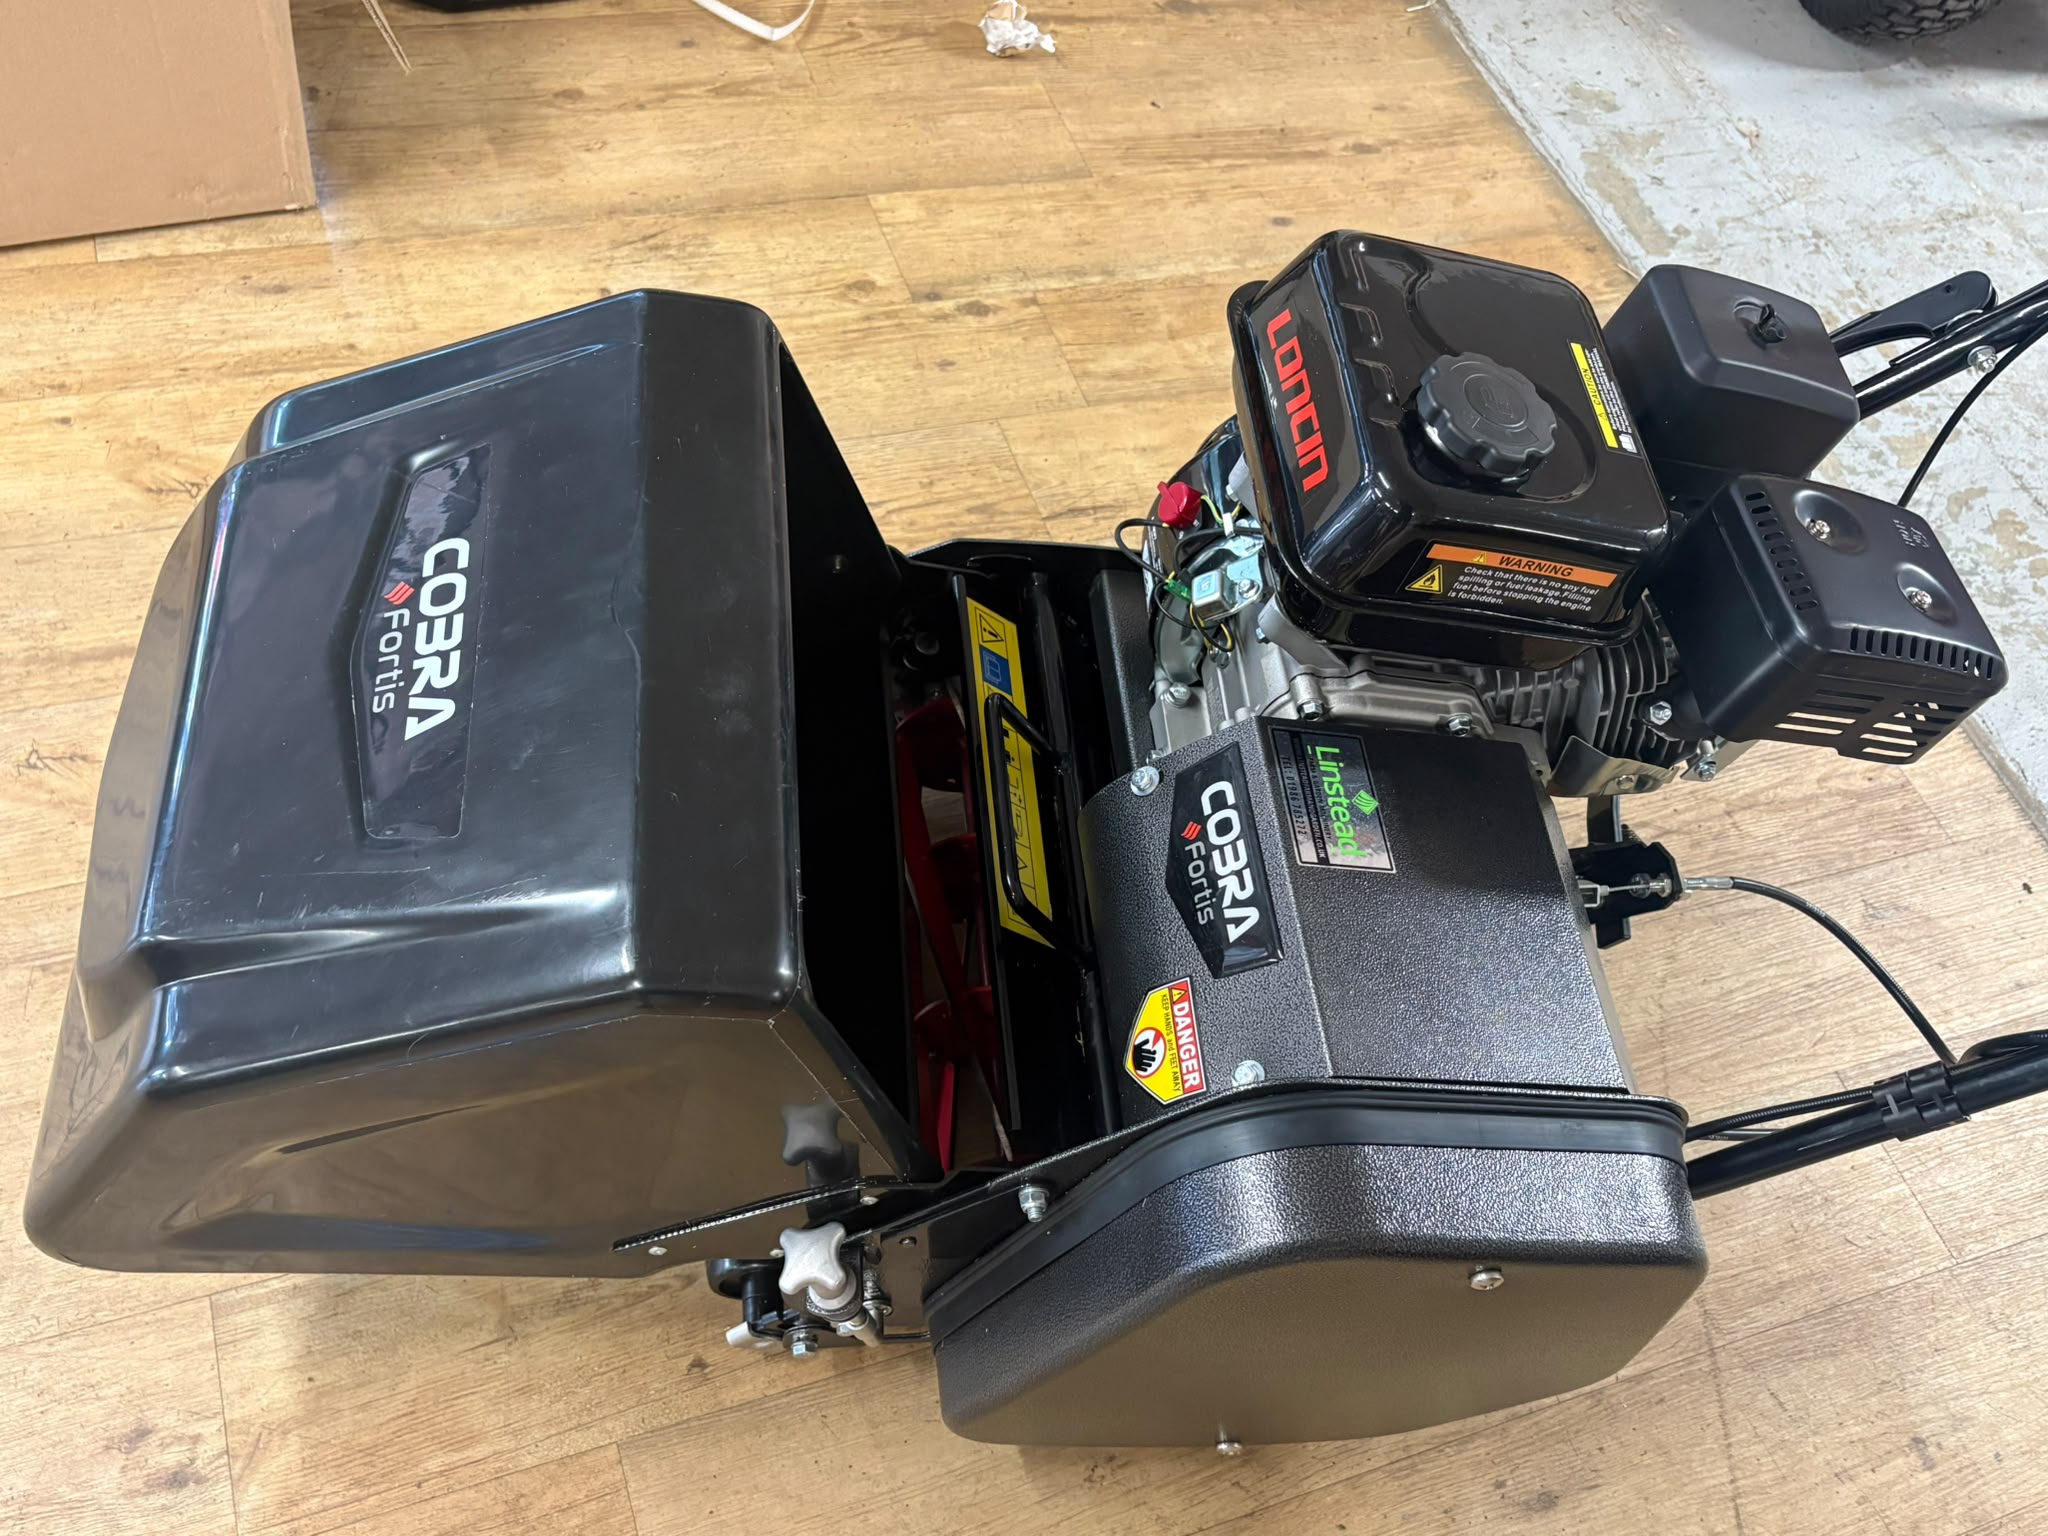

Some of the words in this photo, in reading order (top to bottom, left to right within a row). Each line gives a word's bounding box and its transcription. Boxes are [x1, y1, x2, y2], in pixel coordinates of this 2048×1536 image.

[1582, 368, 1600, 405] CAUTION
[1498, 555, 1574, 577] WARNING
[1457, 573, 1493, 586] spilling
[1505, 581, 1525, 590] fuel
[1464, 566, 1492, 576] Check
[1494, 570, 1513, 579] that
[1513, 574, 1538, 583] there
[1562, 583, 1579, 592] any
[1579, 586, 1599, 595] fuel
[1452, 582, 1471, 590] fuel
[1471, 585, 1502, 595] before
[1502, 590, 1543, 603] stopping
[1544, 597, 1559, 605] the
[1560, 601, 1591, 611] engine
[1457, 591, 1504, 604] forbidden.
[404, 537, 470, 741] COBRA
[372, 608, 411, 714] Fortis
[1281, 756, 1294, 773] TEL:
[1285, 776, 1300, 801] 01986
[1315, 746, 1367, 857] Linstead
[1291, 804, 1307, 834] 785272
[1201, 781, 1260, 943] COBRA
[1184, 841, 1215, 925] Fortis
[1160, 993, 1168, 1010] KEEP
[1163, 1011, 1172, 1035] HANDS
[1167, 1038, 1175, 1050] and
[1173, 1002, 1199, 1088] DANGER
[1169, 1053, 1177, 1069] FEET
[1171, 1071, 1180, 1090] AWAY
